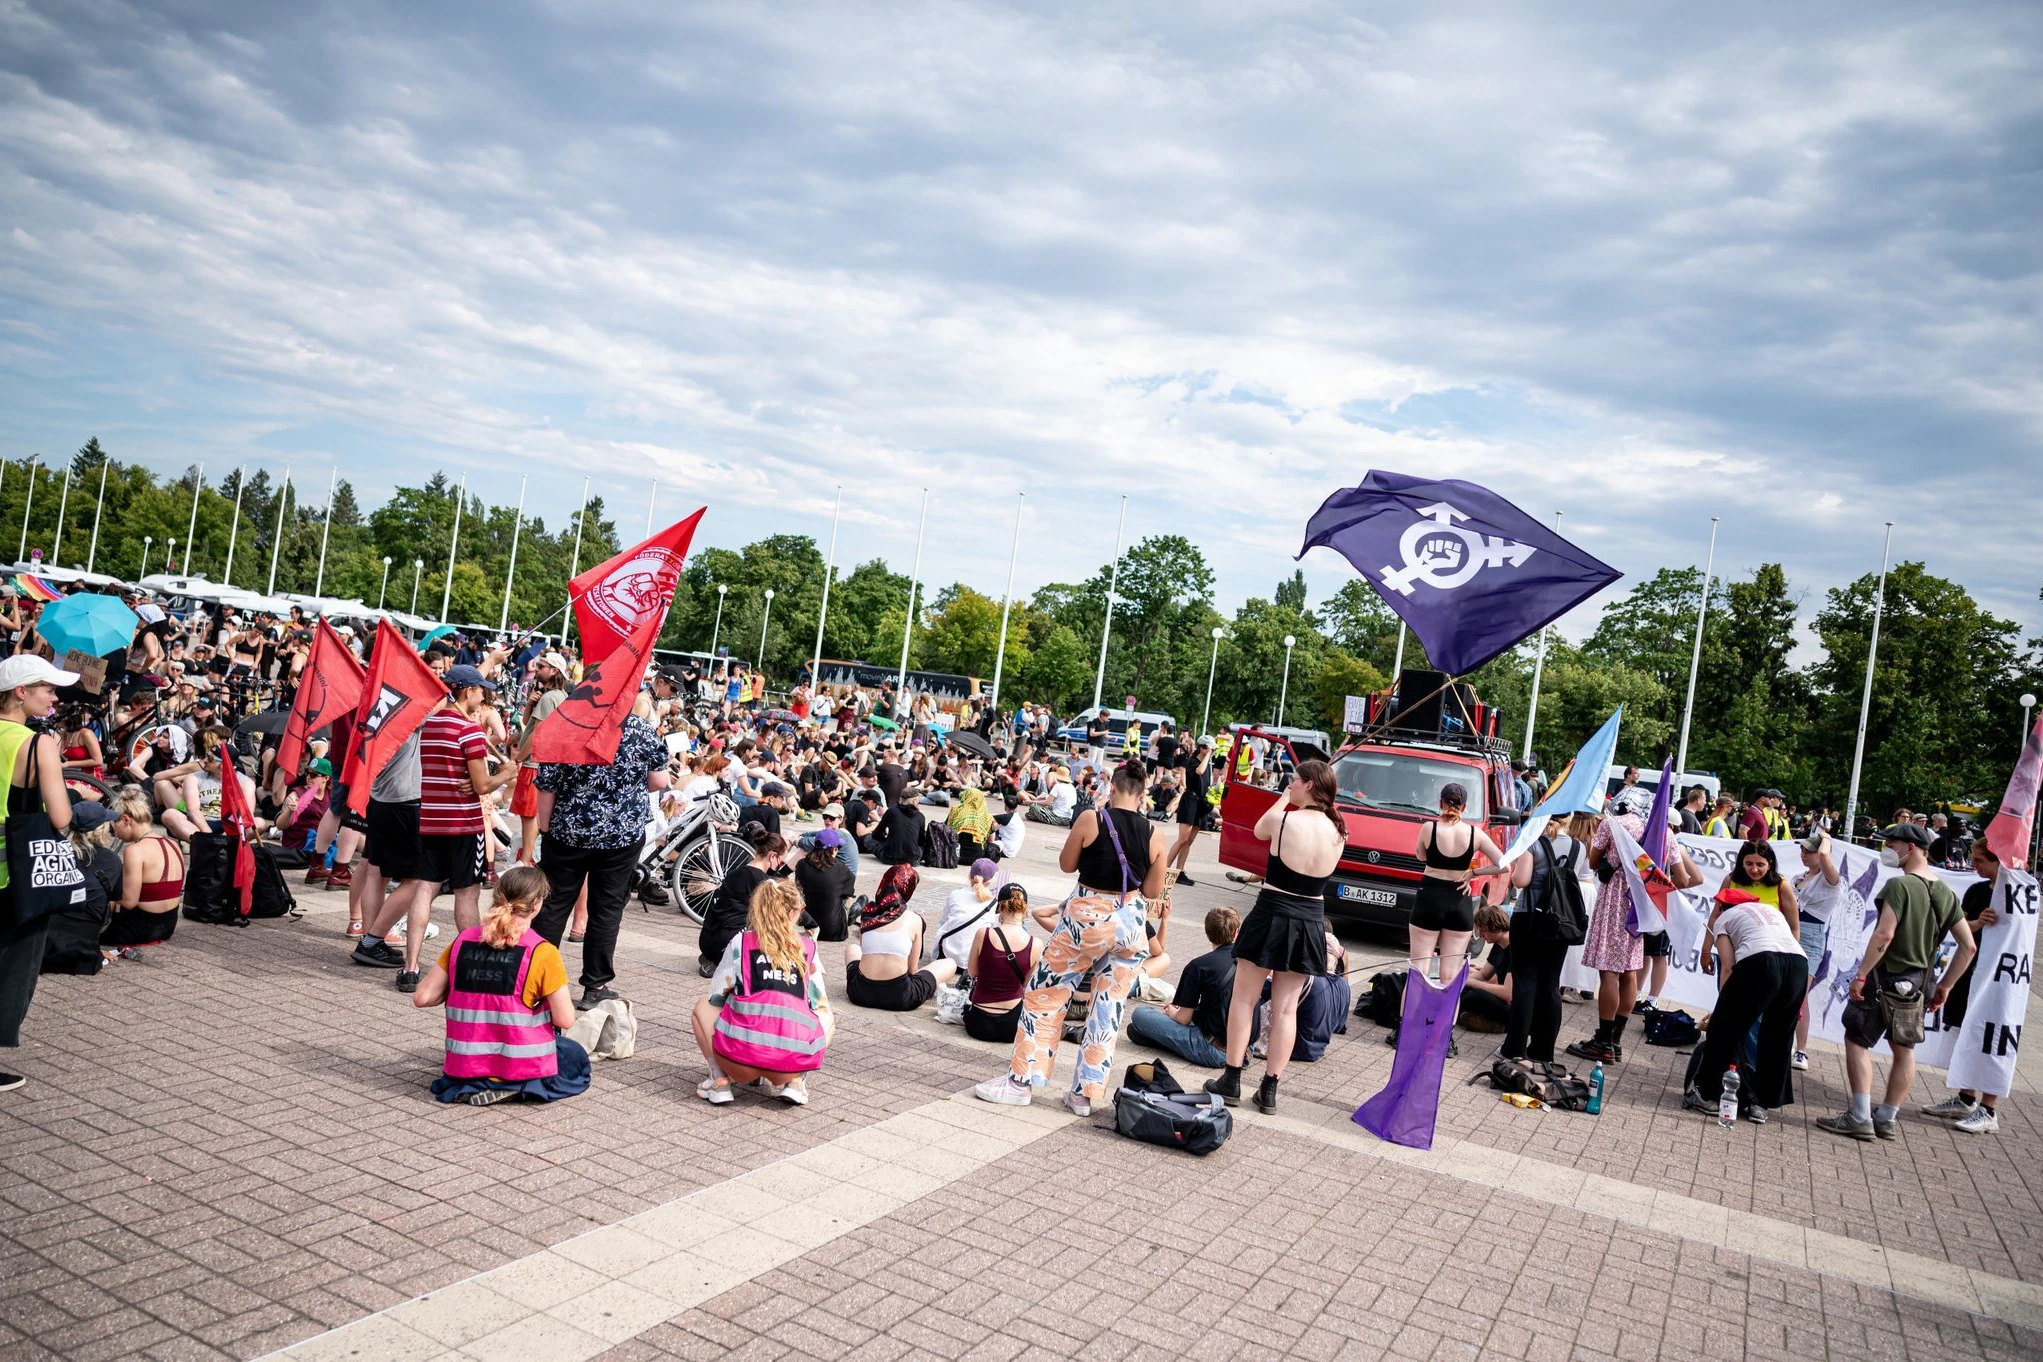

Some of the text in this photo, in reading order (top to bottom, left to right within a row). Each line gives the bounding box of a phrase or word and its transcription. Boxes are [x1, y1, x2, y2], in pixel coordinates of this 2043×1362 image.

[1344, 887, 1396, 904] B AK 1312
[1982, 1022, 2022, 1056] IN
